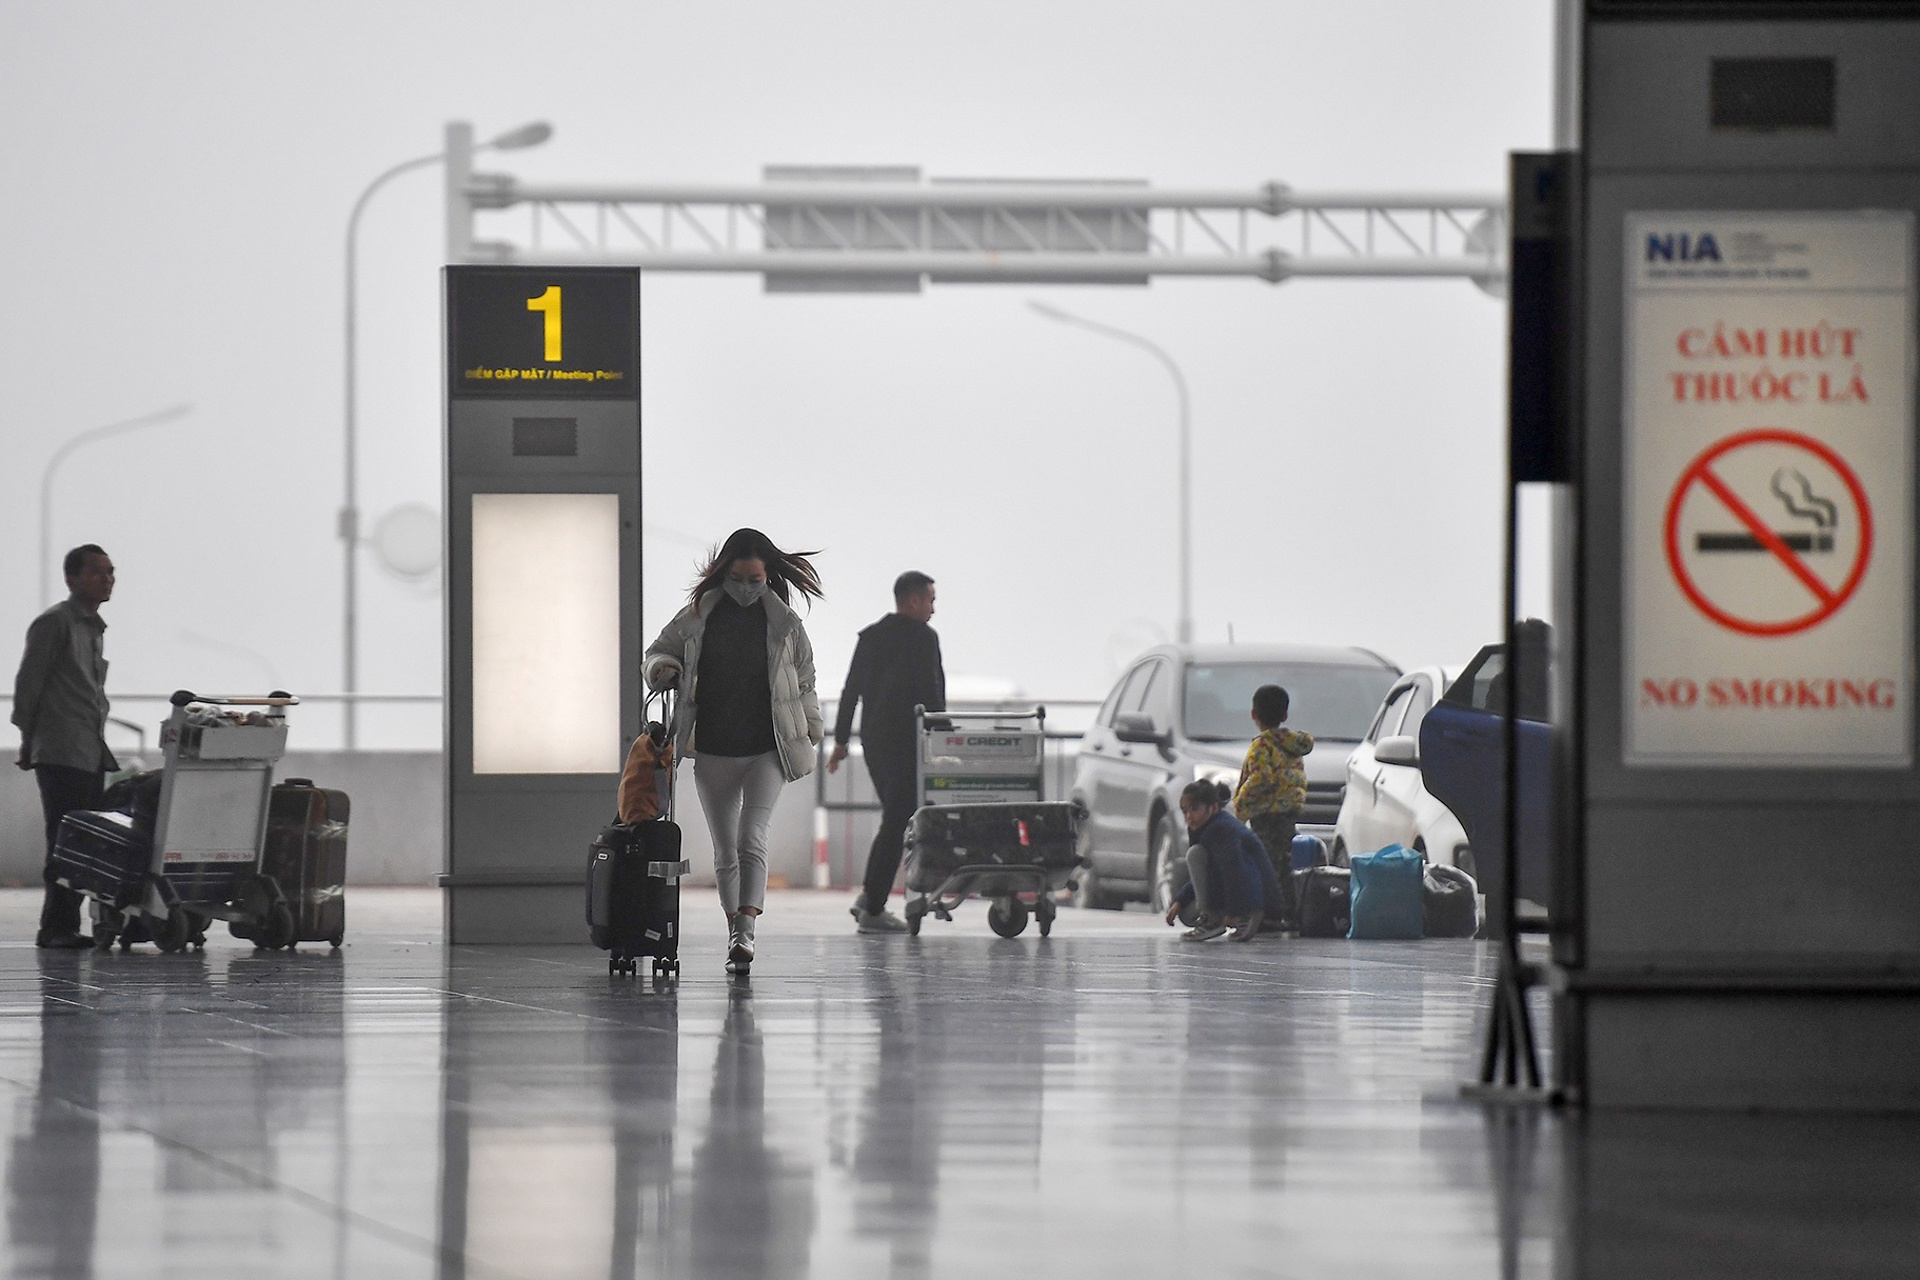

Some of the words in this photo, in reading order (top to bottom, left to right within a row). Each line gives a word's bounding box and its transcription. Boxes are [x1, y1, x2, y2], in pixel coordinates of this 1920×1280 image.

[1646, 232, 1722, 262] NIA
[527, 285, 563, 362] 1
[553, 369, 594, 382] Meeting
[1640, 676, 1699, 709] NO
[1705, 677, 1896, 710] SMOKING
[945, 736, 965, 746] FE
[967, 736, 1022, 746] CREDIT
